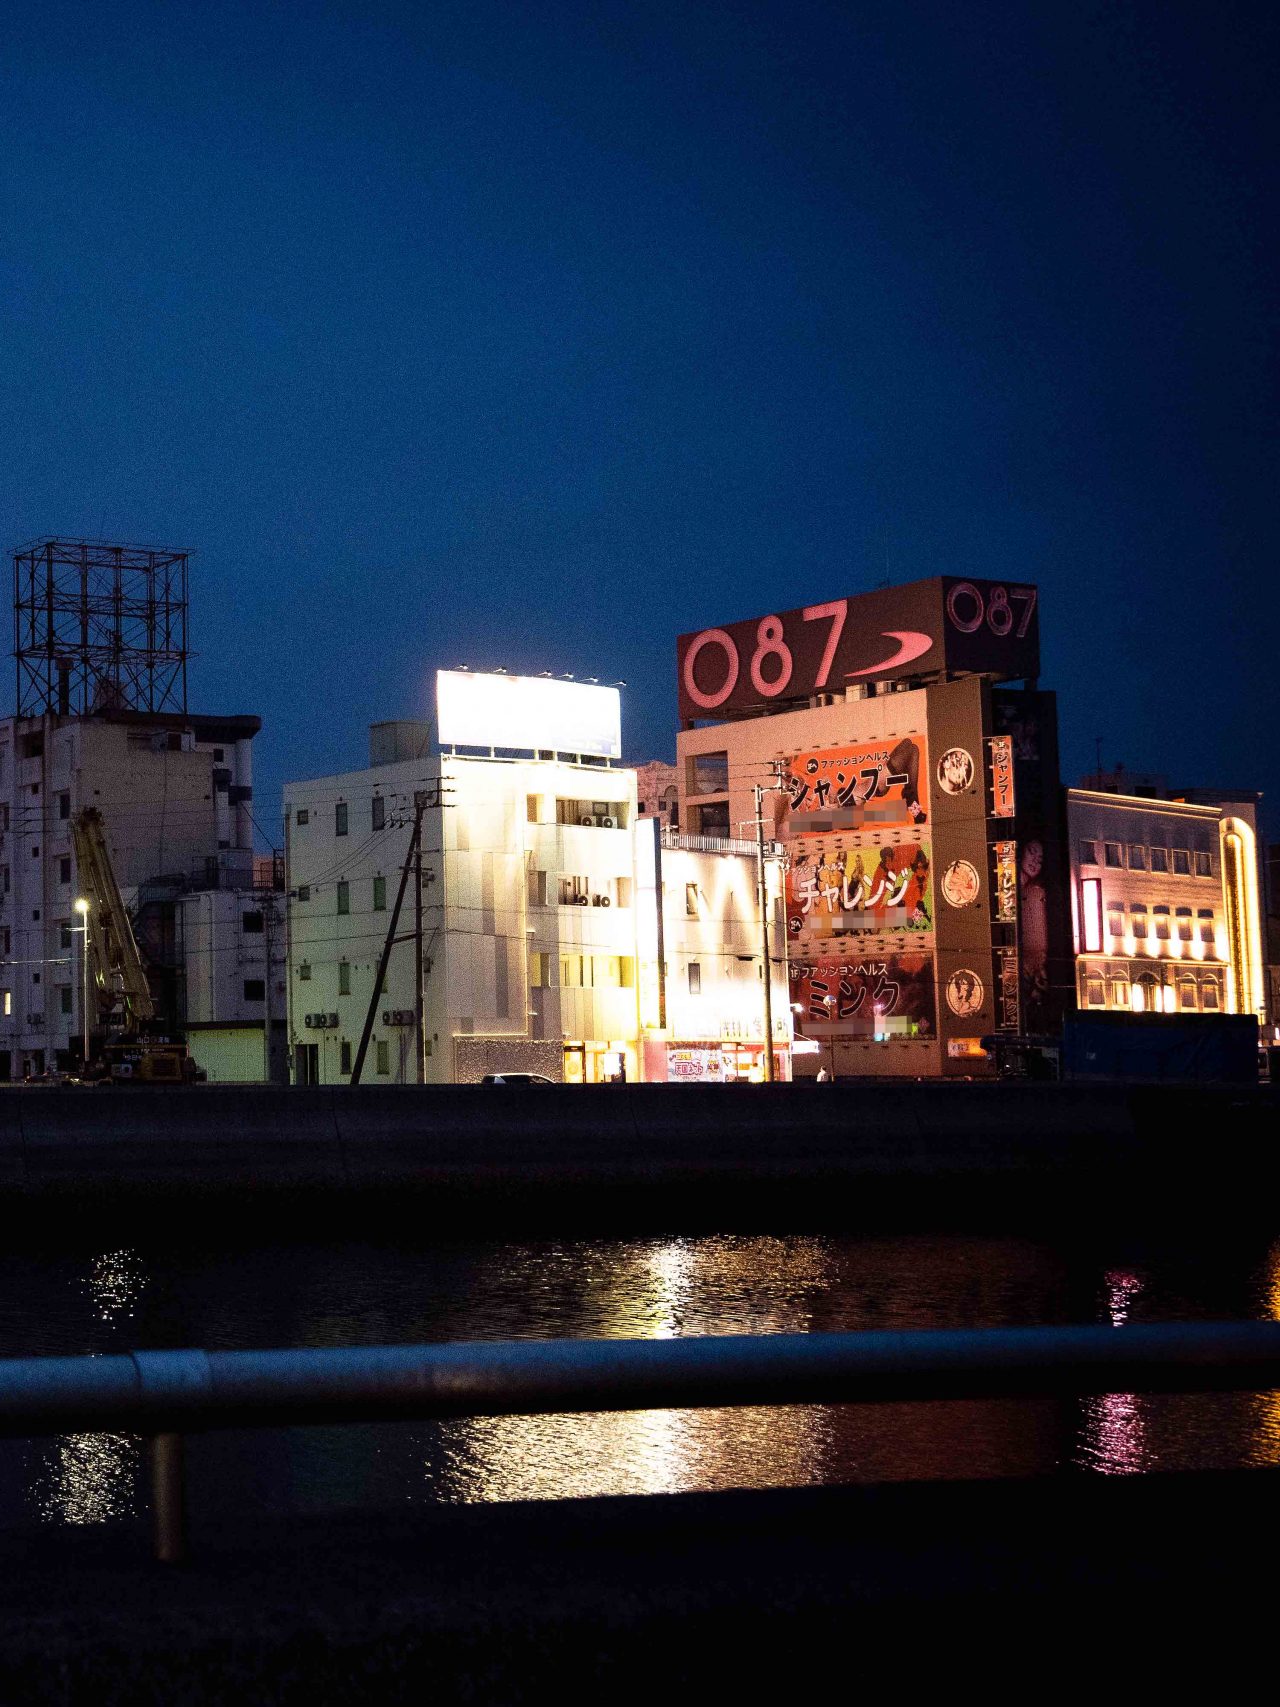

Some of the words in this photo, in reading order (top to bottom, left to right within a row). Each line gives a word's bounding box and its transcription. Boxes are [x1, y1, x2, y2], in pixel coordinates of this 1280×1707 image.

[821, 751, 891, 769] ファッションヘルス
[789, 764, 909, 811] シャンプー
[799, 867, 908, 914] チャレンジ
[801, 963, 889, 979] ファッションヘルス
[1005, 961, 1018, 1016] ミンク
[809, 976, 900, 1019] ミンク
